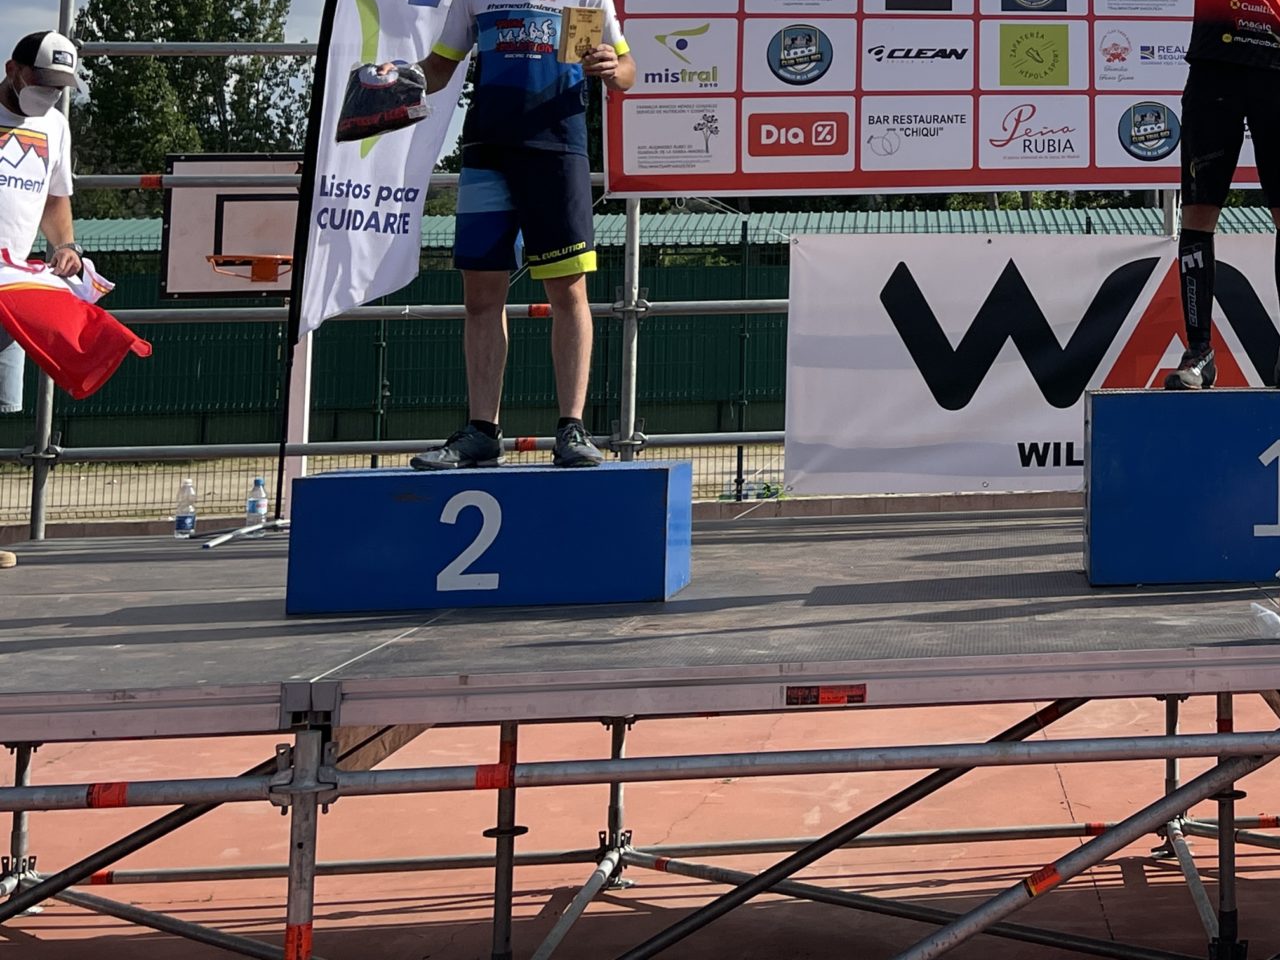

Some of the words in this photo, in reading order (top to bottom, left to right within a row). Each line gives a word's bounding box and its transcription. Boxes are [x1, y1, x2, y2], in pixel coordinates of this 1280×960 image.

[886, 48, 969, 61] CLEAN
[1157, 45, 1188, 54] REAL
[644, 66, 718, 83] mistral
[868, 115, 890, 125] BAR
[892, 114, 967, 125] RESTAURANTE
[899, 127, 944, 137] "CHIQUI"
[1023, 139, 1075, 153] RUBIA
[0, 174, 45, 193] ement
[319, 174, 371, 200] Listos
[316, 206, 411, 235] CUIDARTE
[1017, 441, 1085, 467] WIL
[436, 490, 502, 591] 2
